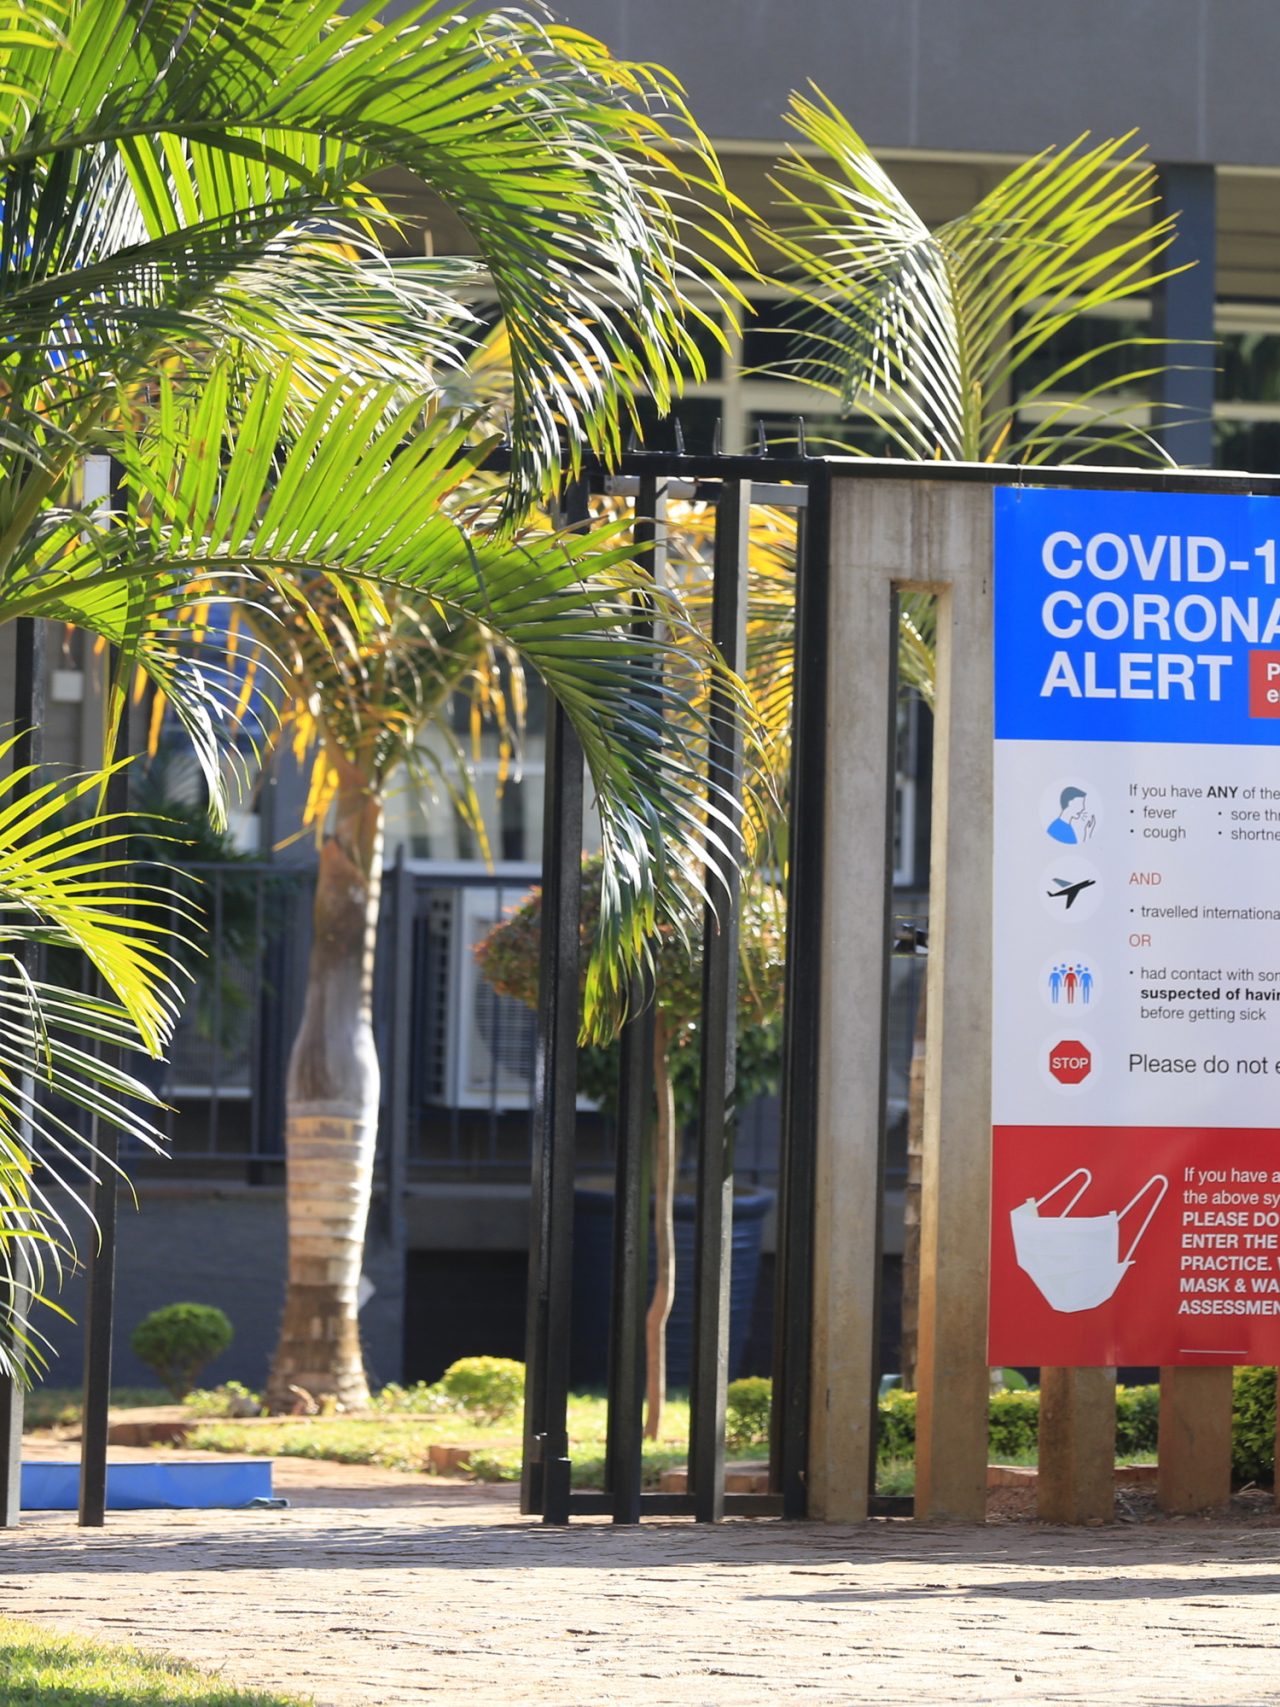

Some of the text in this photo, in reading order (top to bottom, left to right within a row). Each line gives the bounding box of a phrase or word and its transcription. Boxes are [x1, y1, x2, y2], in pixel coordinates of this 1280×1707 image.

[1040, 651, 1232, 701] ALERT
[1130, 784, 1137, 796] If
[1142, 787, 1166, 800] you
[1171, 785, 1202, 798] have
[1207, 786, 1238, 798] ANY
[1243, 787, 1256, 799] of
[1143, 806, 1176, 819] fever
[1231, 811, 1260, 821] sore
[1143, 826, 1186, 841] cough
[1129, 872, 1161, 885] AND
[1141, 906, 1198, 918] travelled
[1129, 934, 1151, 947] OR
[1141, 967, 1166, 979] had
[1171, 969, 1222, 980] contact
[1227, 969, 1254, 981] with
[1141, 988, 1220, 1001] suspected
[1226, 988, 1240, 1000] of
[1141, 1006, 1266, 1023] before getting sick
[1052, 1057, 1088, 1069] STOP
[1130, 1054, 1196, 1073] Please
[1204, 1055, 1229, 1073] do
[1237, 1057, 1268, 1074] not
[1185, 1167, 1194, 1181] If
[1198, 1171, 1226, 1185] you
[1231, 1168, 1267, 1182] have
[1183, 1190, 1207, 1204] the
[1212, 1190, 1259, 1204] above
[1183, 1212, 1248, 1226] PLEASE
[1254, 1212, 1279, 1227] DO
[1182, 1234, 1278, 1249] ENTER THE
[1181, 1256, 1272, 1271] PRACTICE.
[1180, 1278, 1230, 1292] MASK
[1234, 1278, 1246, 1292] &
